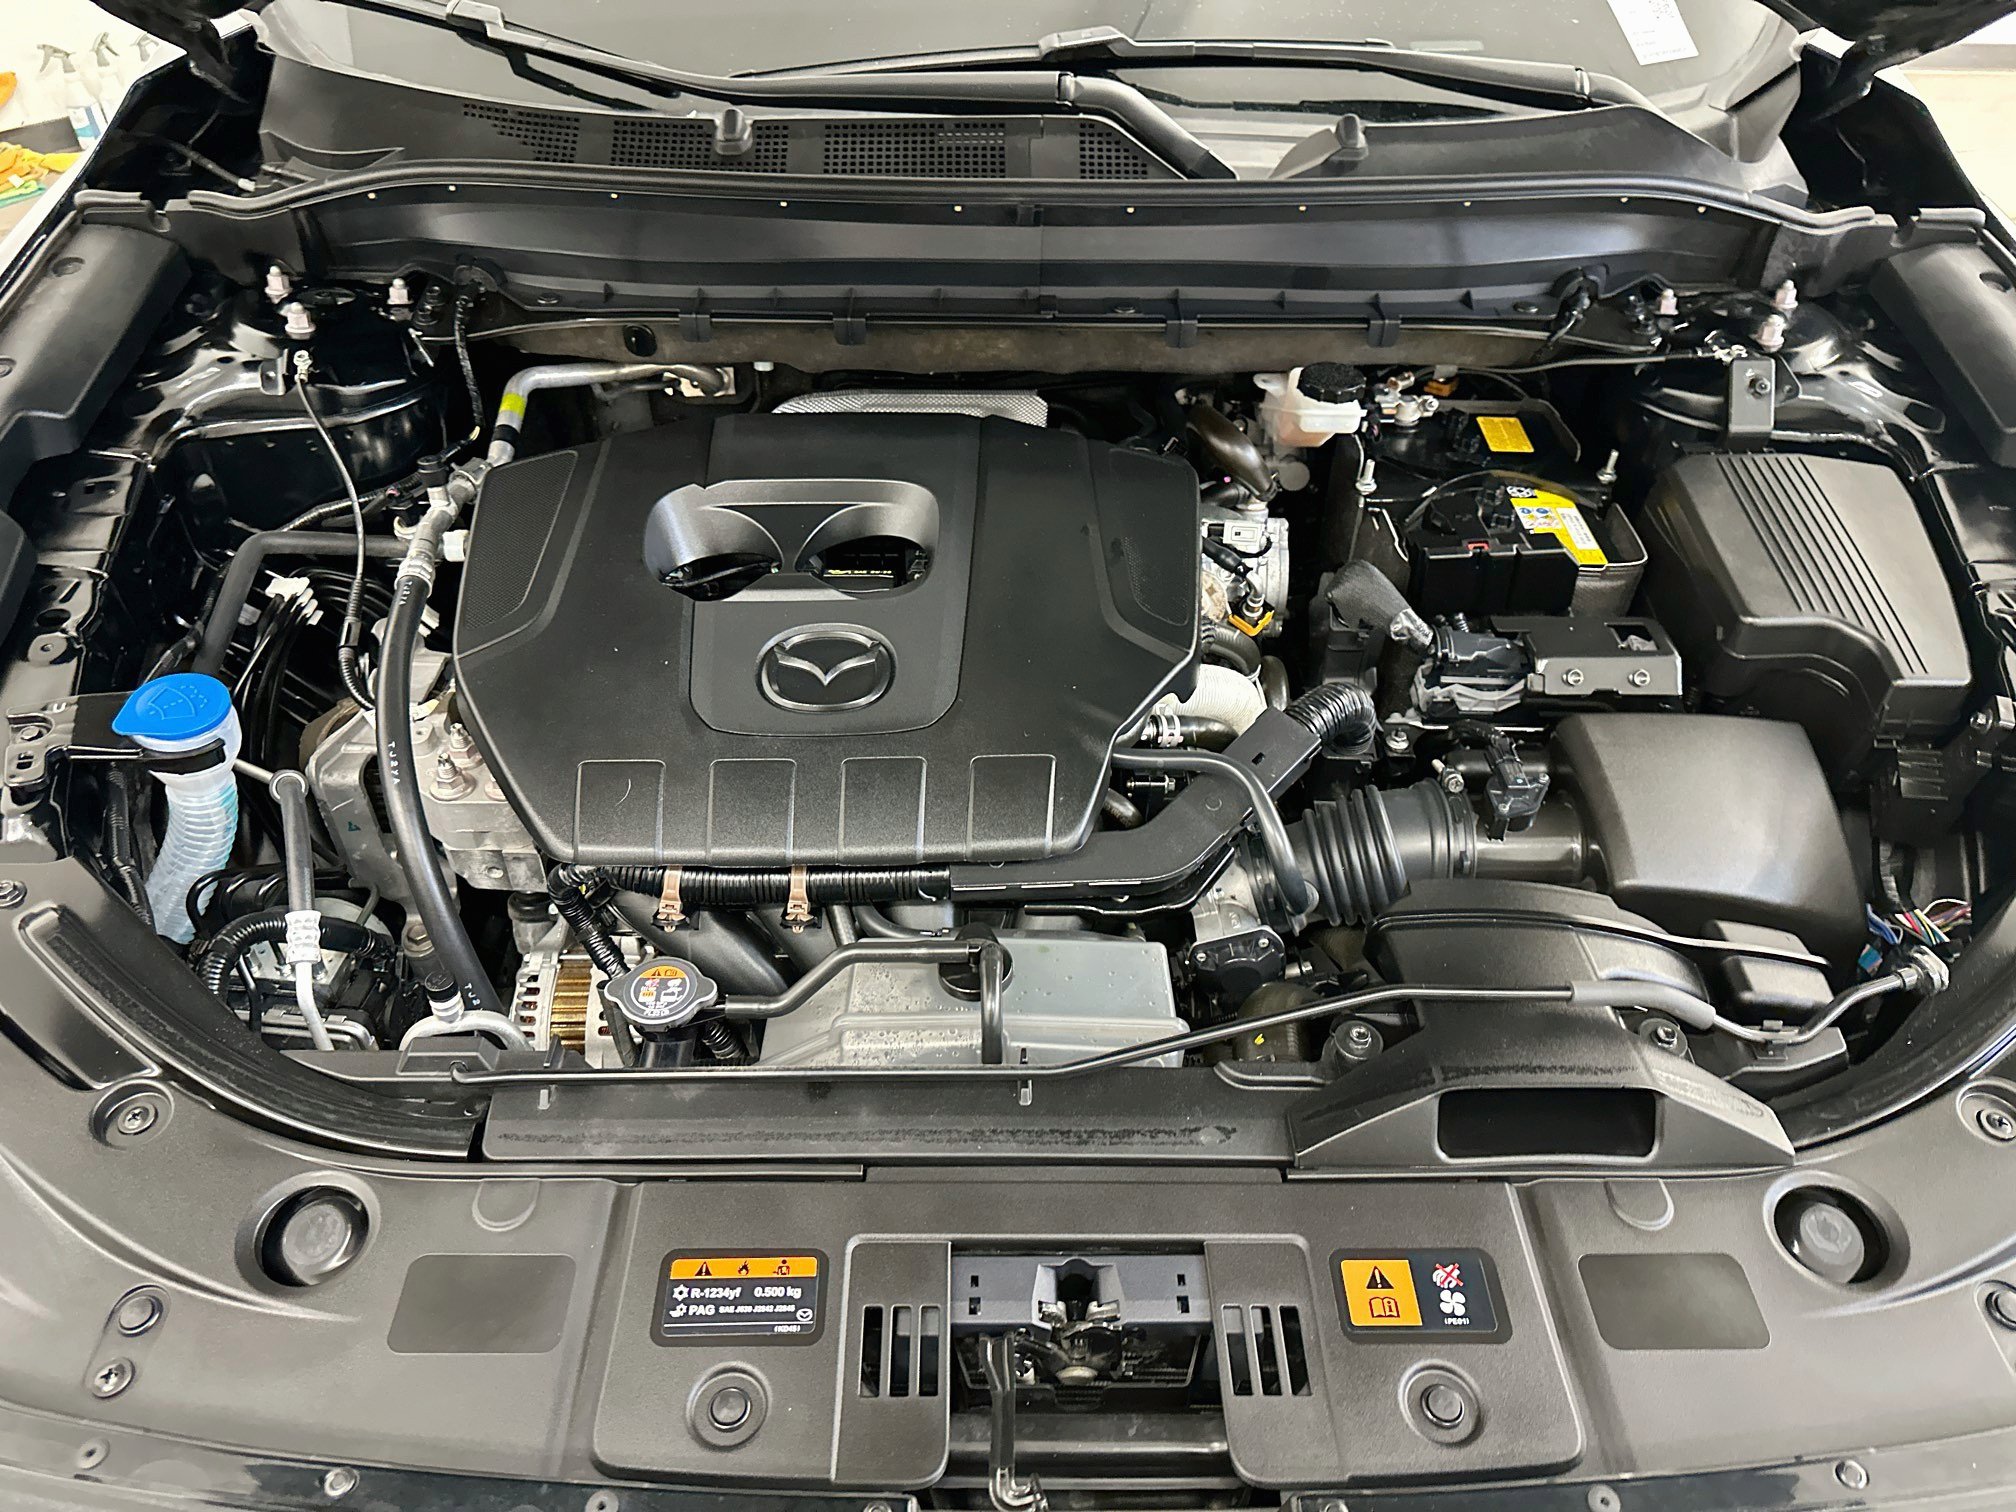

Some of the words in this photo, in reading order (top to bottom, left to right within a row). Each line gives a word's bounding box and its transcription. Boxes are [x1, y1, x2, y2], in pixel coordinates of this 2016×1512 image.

[690, 1286, 742, 1300] R-1234yf
[753, 1286, 785, 1298] 0.500
[786, 1286, 802, 1299] kg
[689, 1304, 716, 1316] PAG
